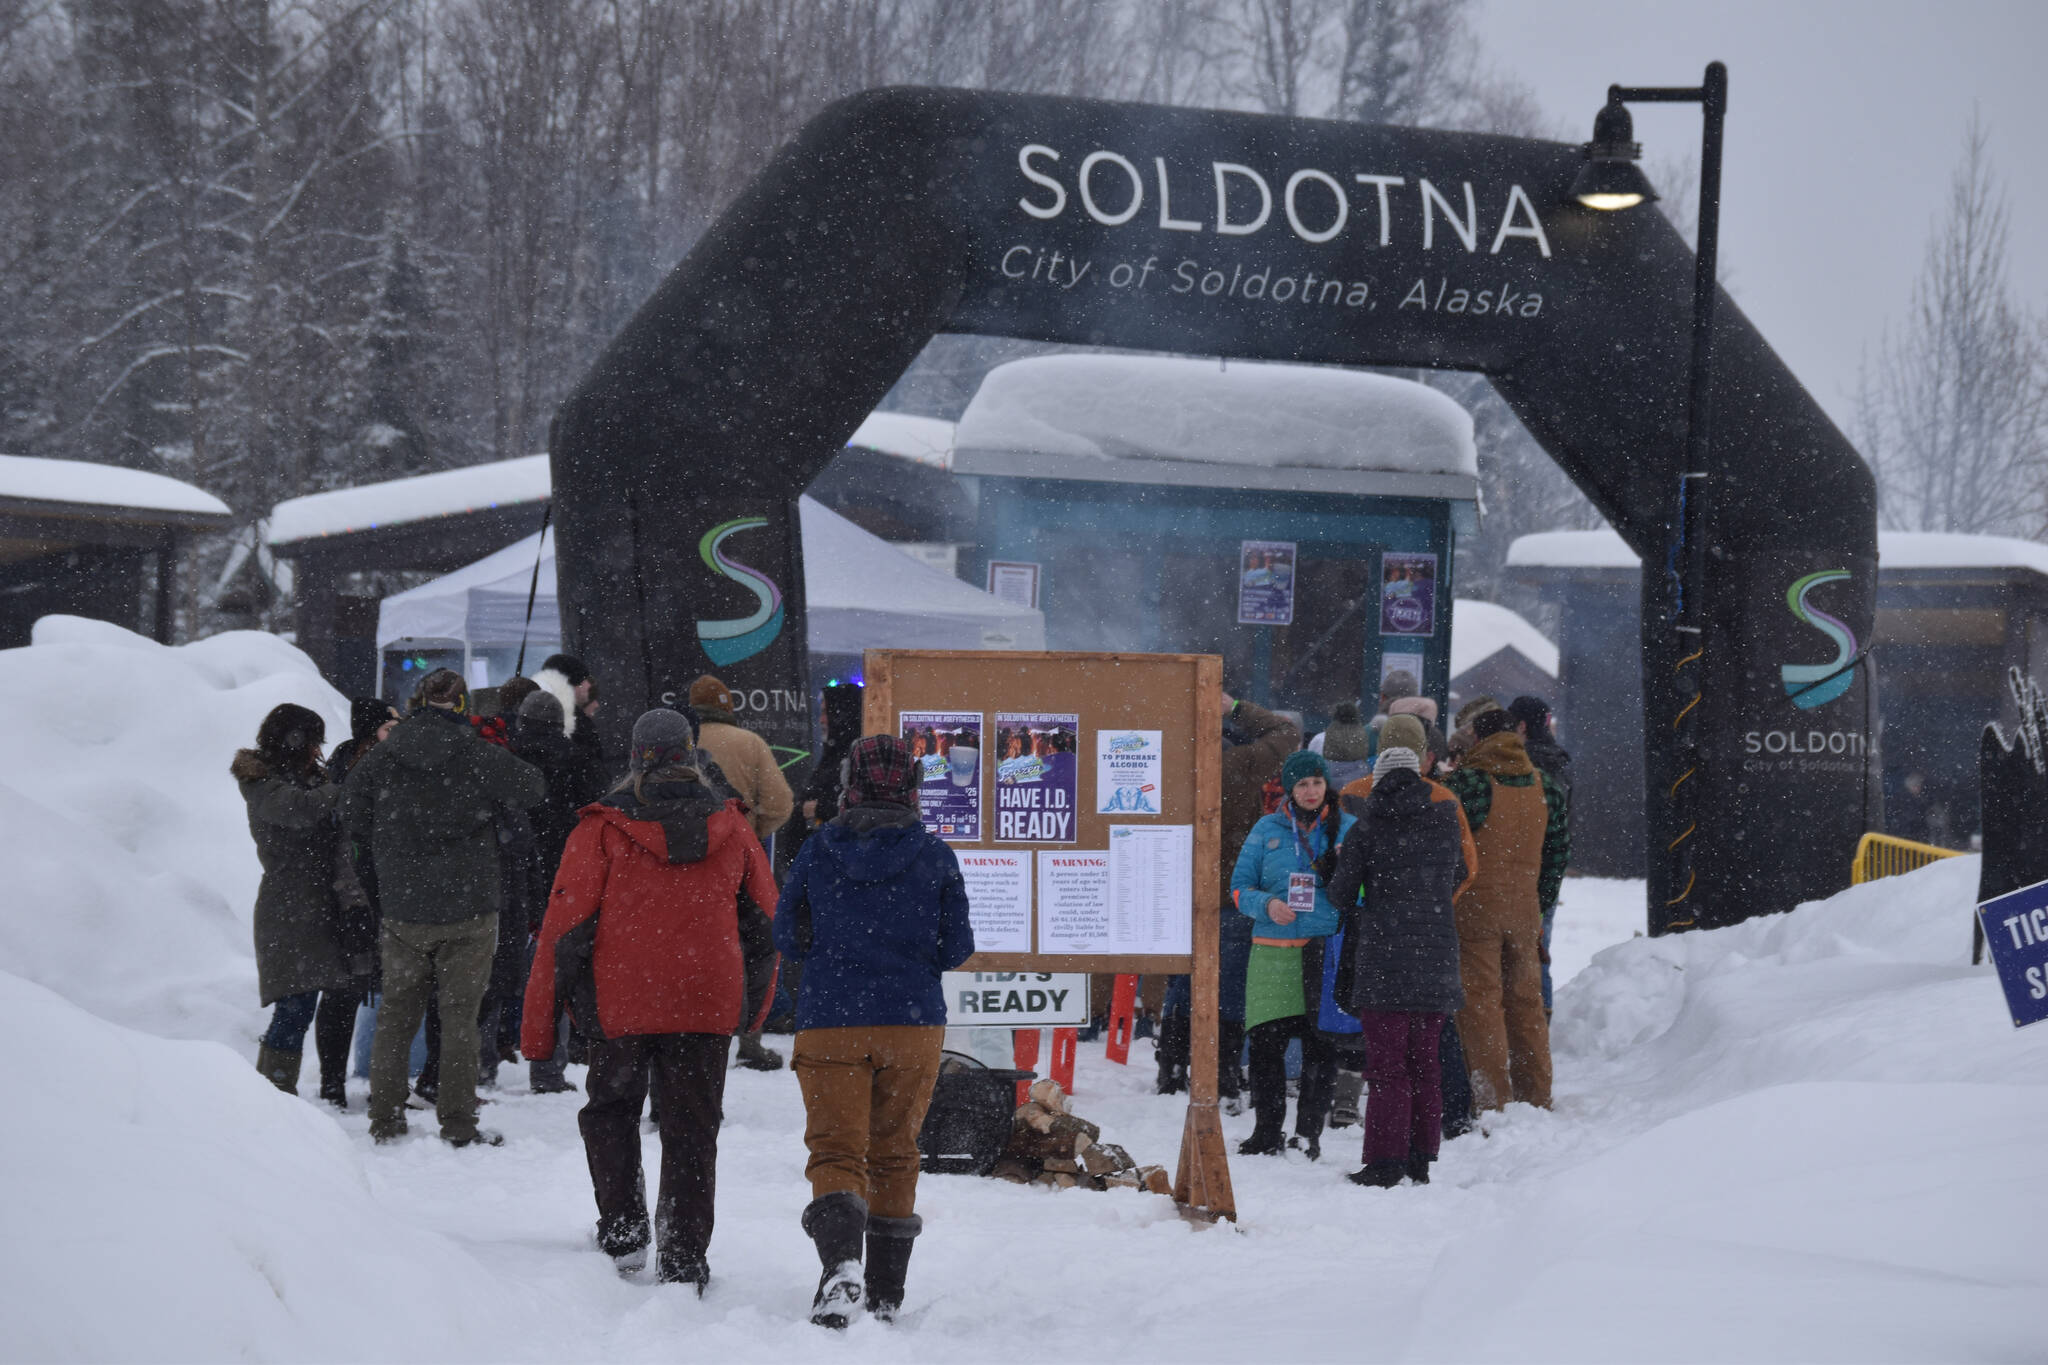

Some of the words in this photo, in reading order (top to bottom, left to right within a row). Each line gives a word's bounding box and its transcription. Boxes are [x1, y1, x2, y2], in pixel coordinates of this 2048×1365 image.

[1018, 143, 1552, 258] SOLDOTNA
[1001, 245, 1090, 290] City
[1110, 257, 1159, 289] of
[1171, 260, 1378, 311] Soldotna,
[1398, 278, 1545, 318] Alaska
[661, 689, 808, 712] SDOTNA
[965, 788, 976, 796] $25
[969, 799, 976, 807] $5
[1000, 788, 1041, 808] HAVE
[1045, 788, 1070, 808] I.D.
[936, 814, 944, 823] $3
[1000, 811, 1071, 839] READY
[2003, 906, 2048, 950] TIC
[959, 989, 1070, 1013] READY
